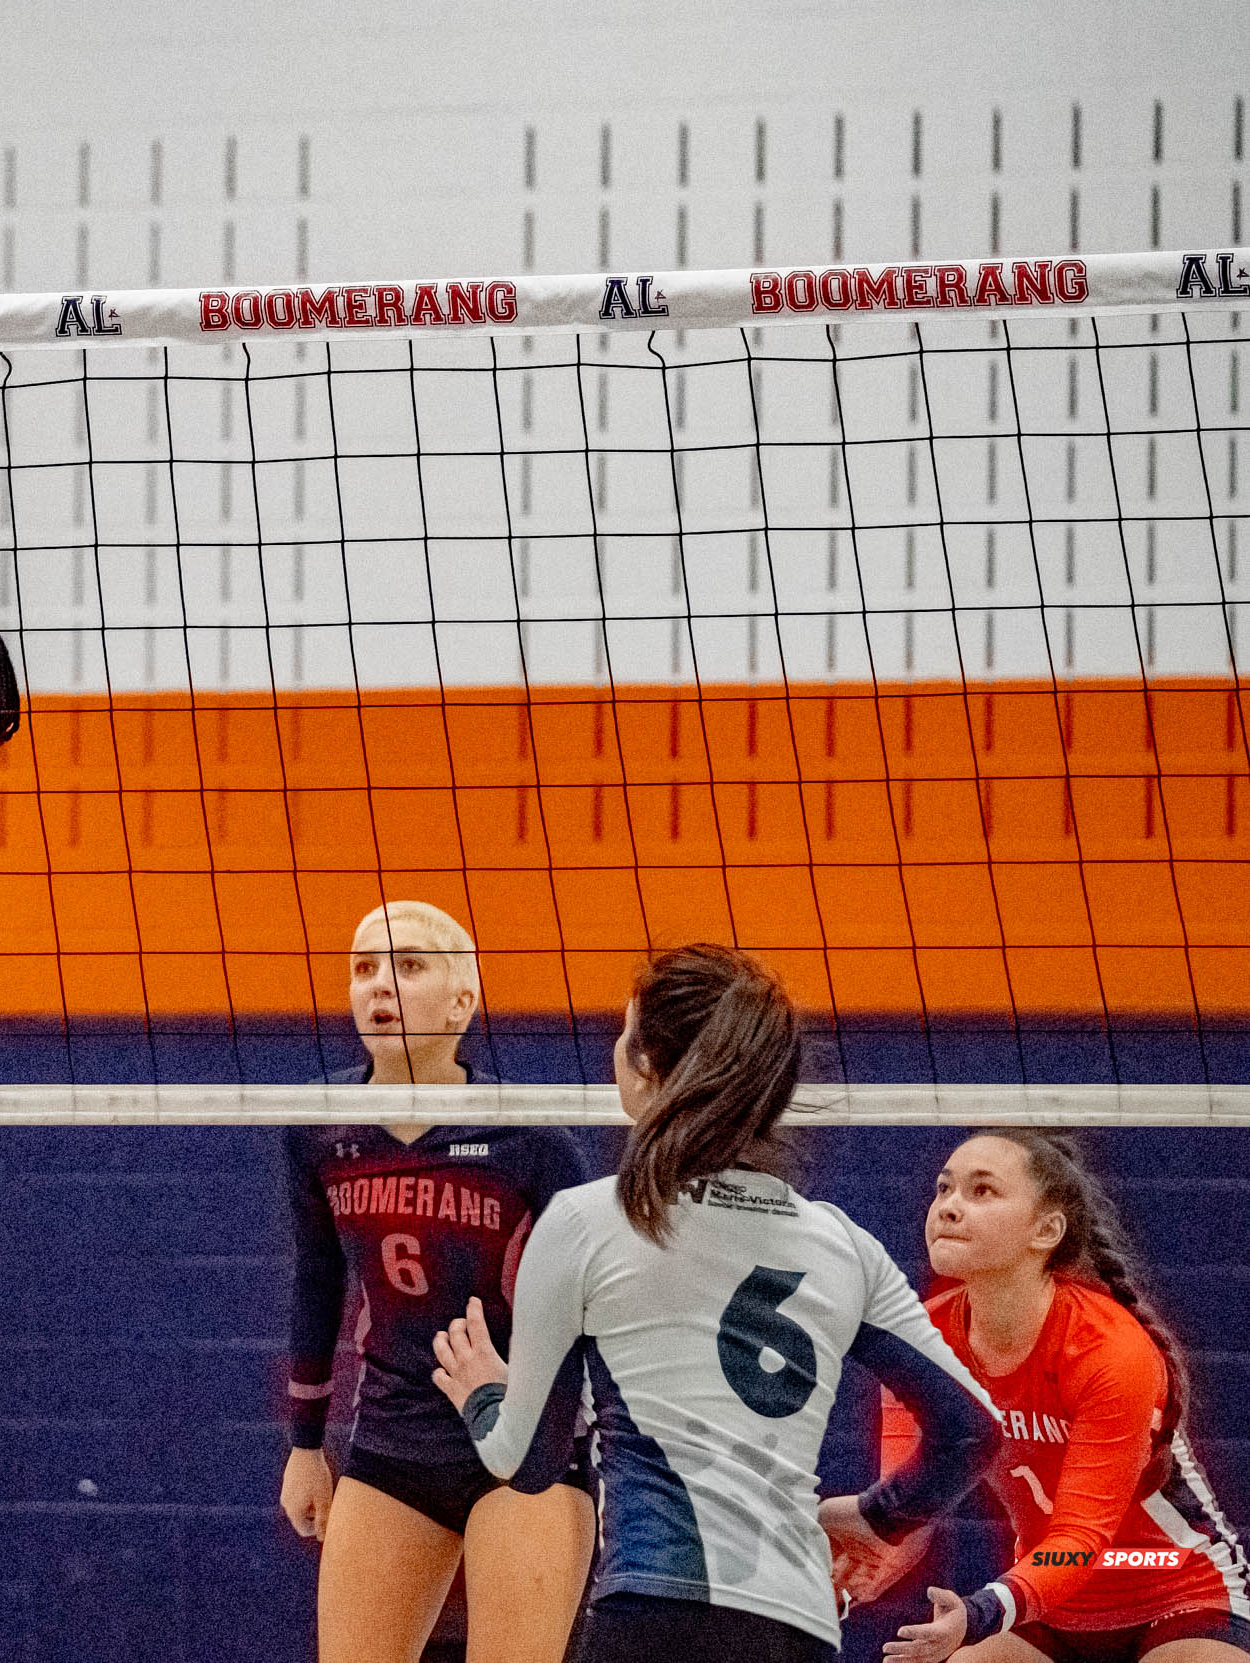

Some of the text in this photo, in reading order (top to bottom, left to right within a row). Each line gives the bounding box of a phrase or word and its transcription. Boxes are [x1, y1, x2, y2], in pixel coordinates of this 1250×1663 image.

[198, 281, 519, 332] BOOMERANG
[749, 259, 1089, 315] BOOMERANG
[326, 1176, 501, 1231] BOOMERANG
[381, 1232, 430, 1297] 6
[716, 1264, 819, 1419] 6
